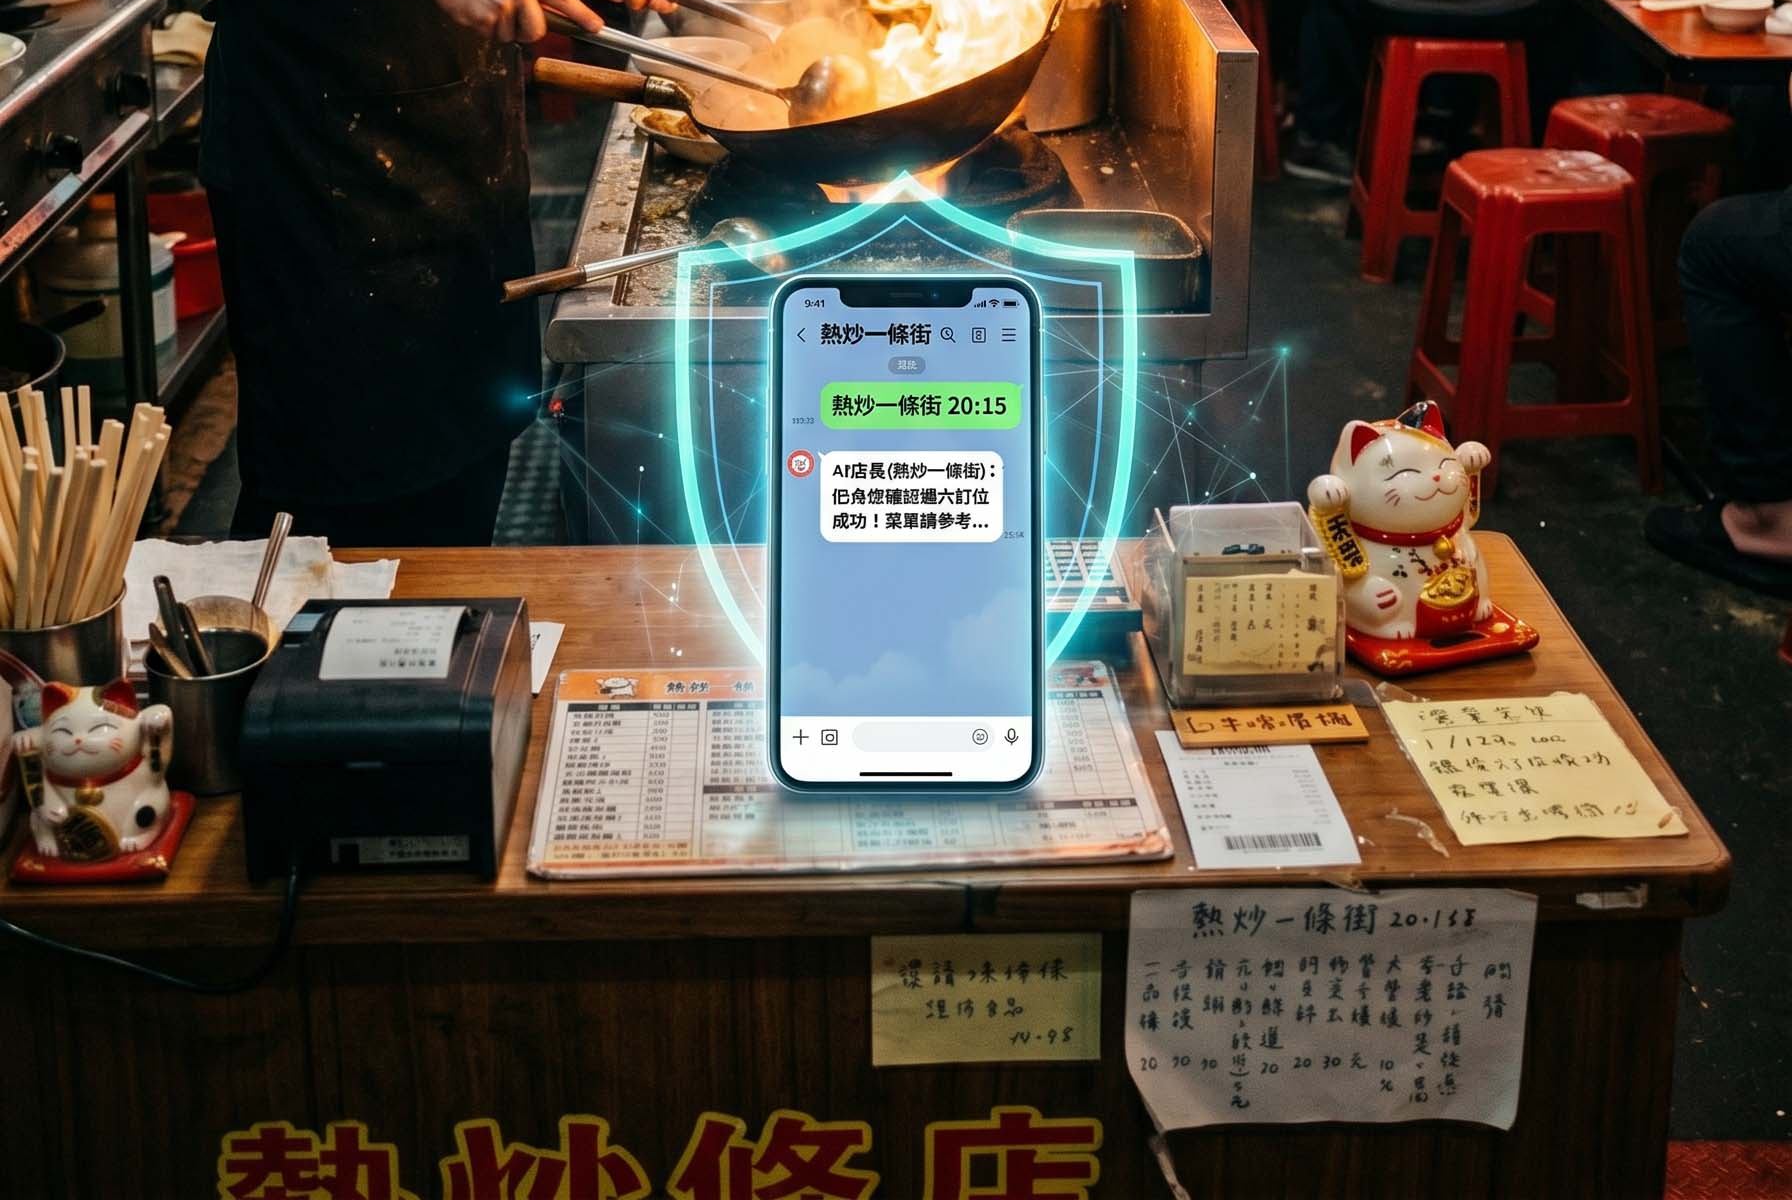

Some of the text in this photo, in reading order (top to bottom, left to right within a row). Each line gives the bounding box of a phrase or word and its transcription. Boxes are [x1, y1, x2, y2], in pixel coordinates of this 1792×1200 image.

[804, 299, 825, 308] 9:41
[820, 323, 932, 345] 熱炒一條街
[832, 394, 1007, 417] 熱炒一條街 20:15
